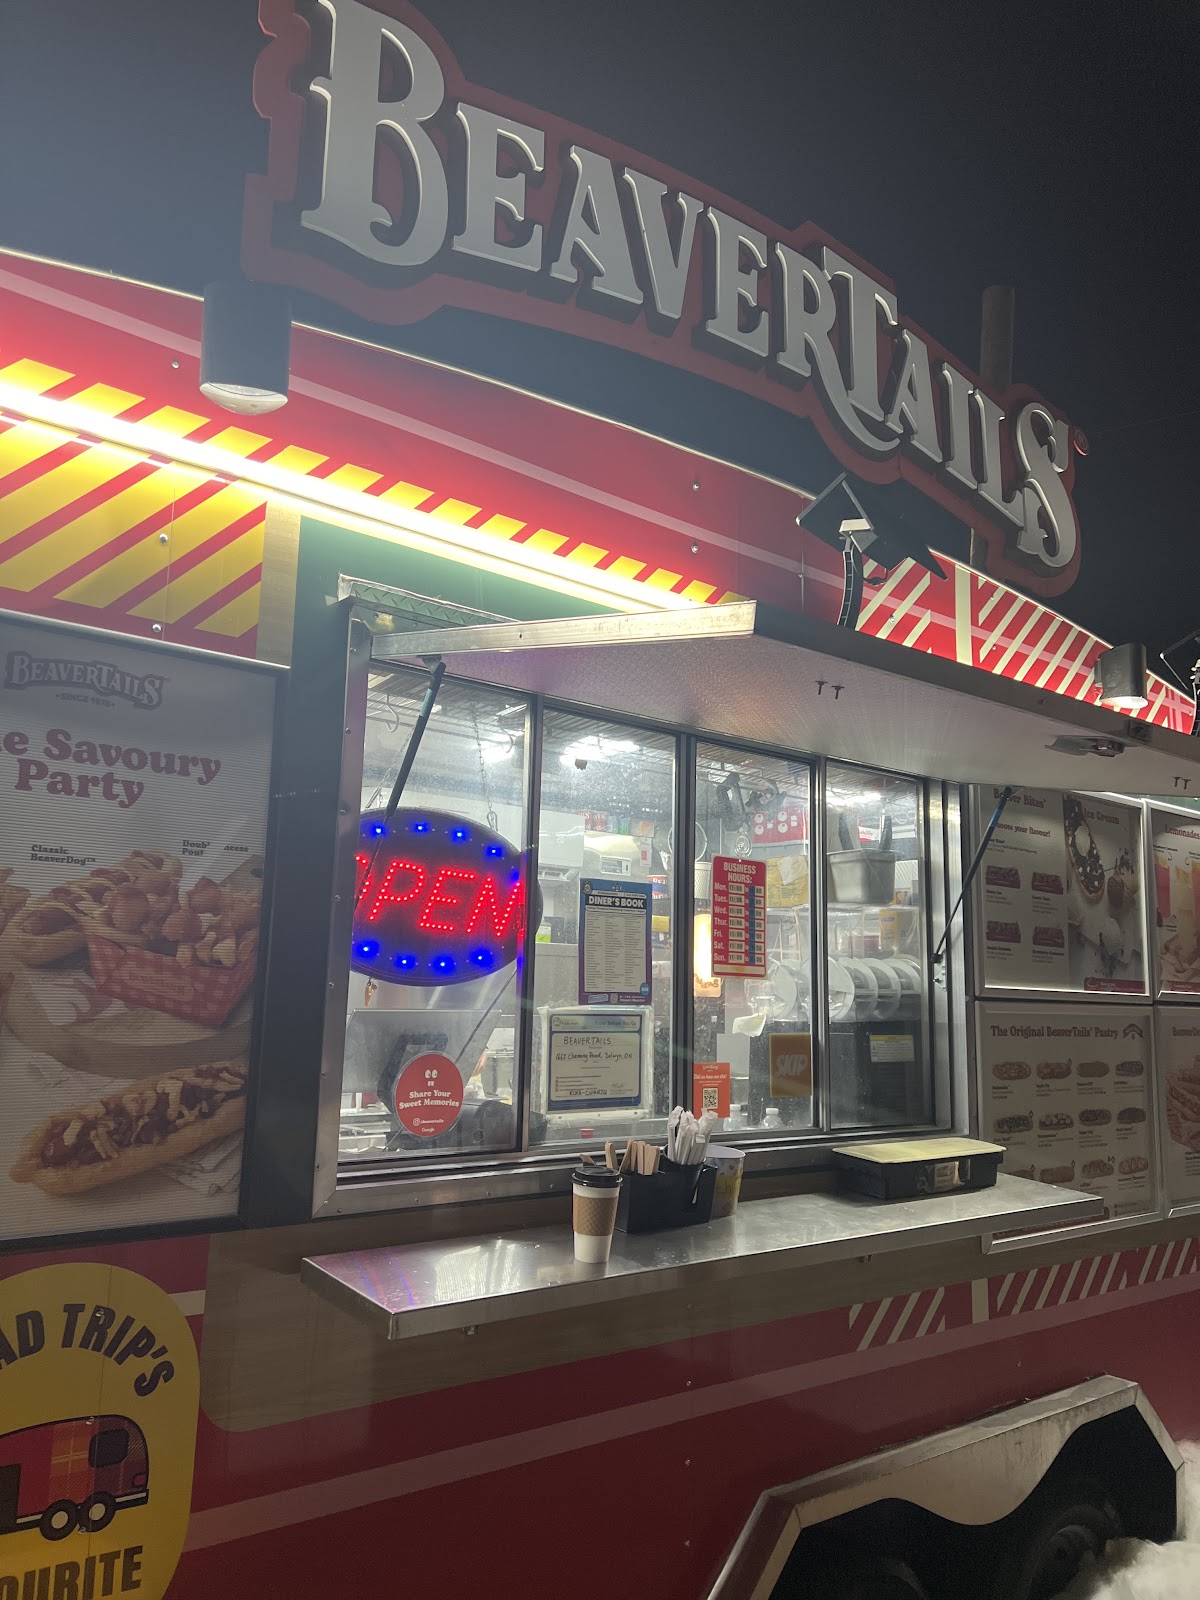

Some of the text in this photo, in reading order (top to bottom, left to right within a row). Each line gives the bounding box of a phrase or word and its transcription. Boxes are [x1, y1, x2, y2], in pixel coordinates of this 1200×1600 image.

[44, 728, 222, 786] Savoury
[14, 758, 144, 809] Party
[1083, 807, 1120, 825] Ice Cream
[1014, 825, 1028, 834] your
[31, 844, 69, 855] Classic
[723, 861, 757, 875] BUSINESS
[727, 871, 753, 884] HOURS:
[353, 853, 522, 938] PEN
[588, 895, 644, 908] DINER'S BOOK
[990, 1025, 1008, 1037] The
[1010, 1026, 1045, 1039] Original
[1094, 1027, 1119, 1040] Pastry
[563, 1036, 612, 1046] BEAVERTAILS
[775, 1053, 808, 1077] SKIP
[409, 1090, 452, 1099] Share Your
[398, 1098, 460, 1110] Sweet Memories
[61, 1303, 175, 1397] TRIP'S
